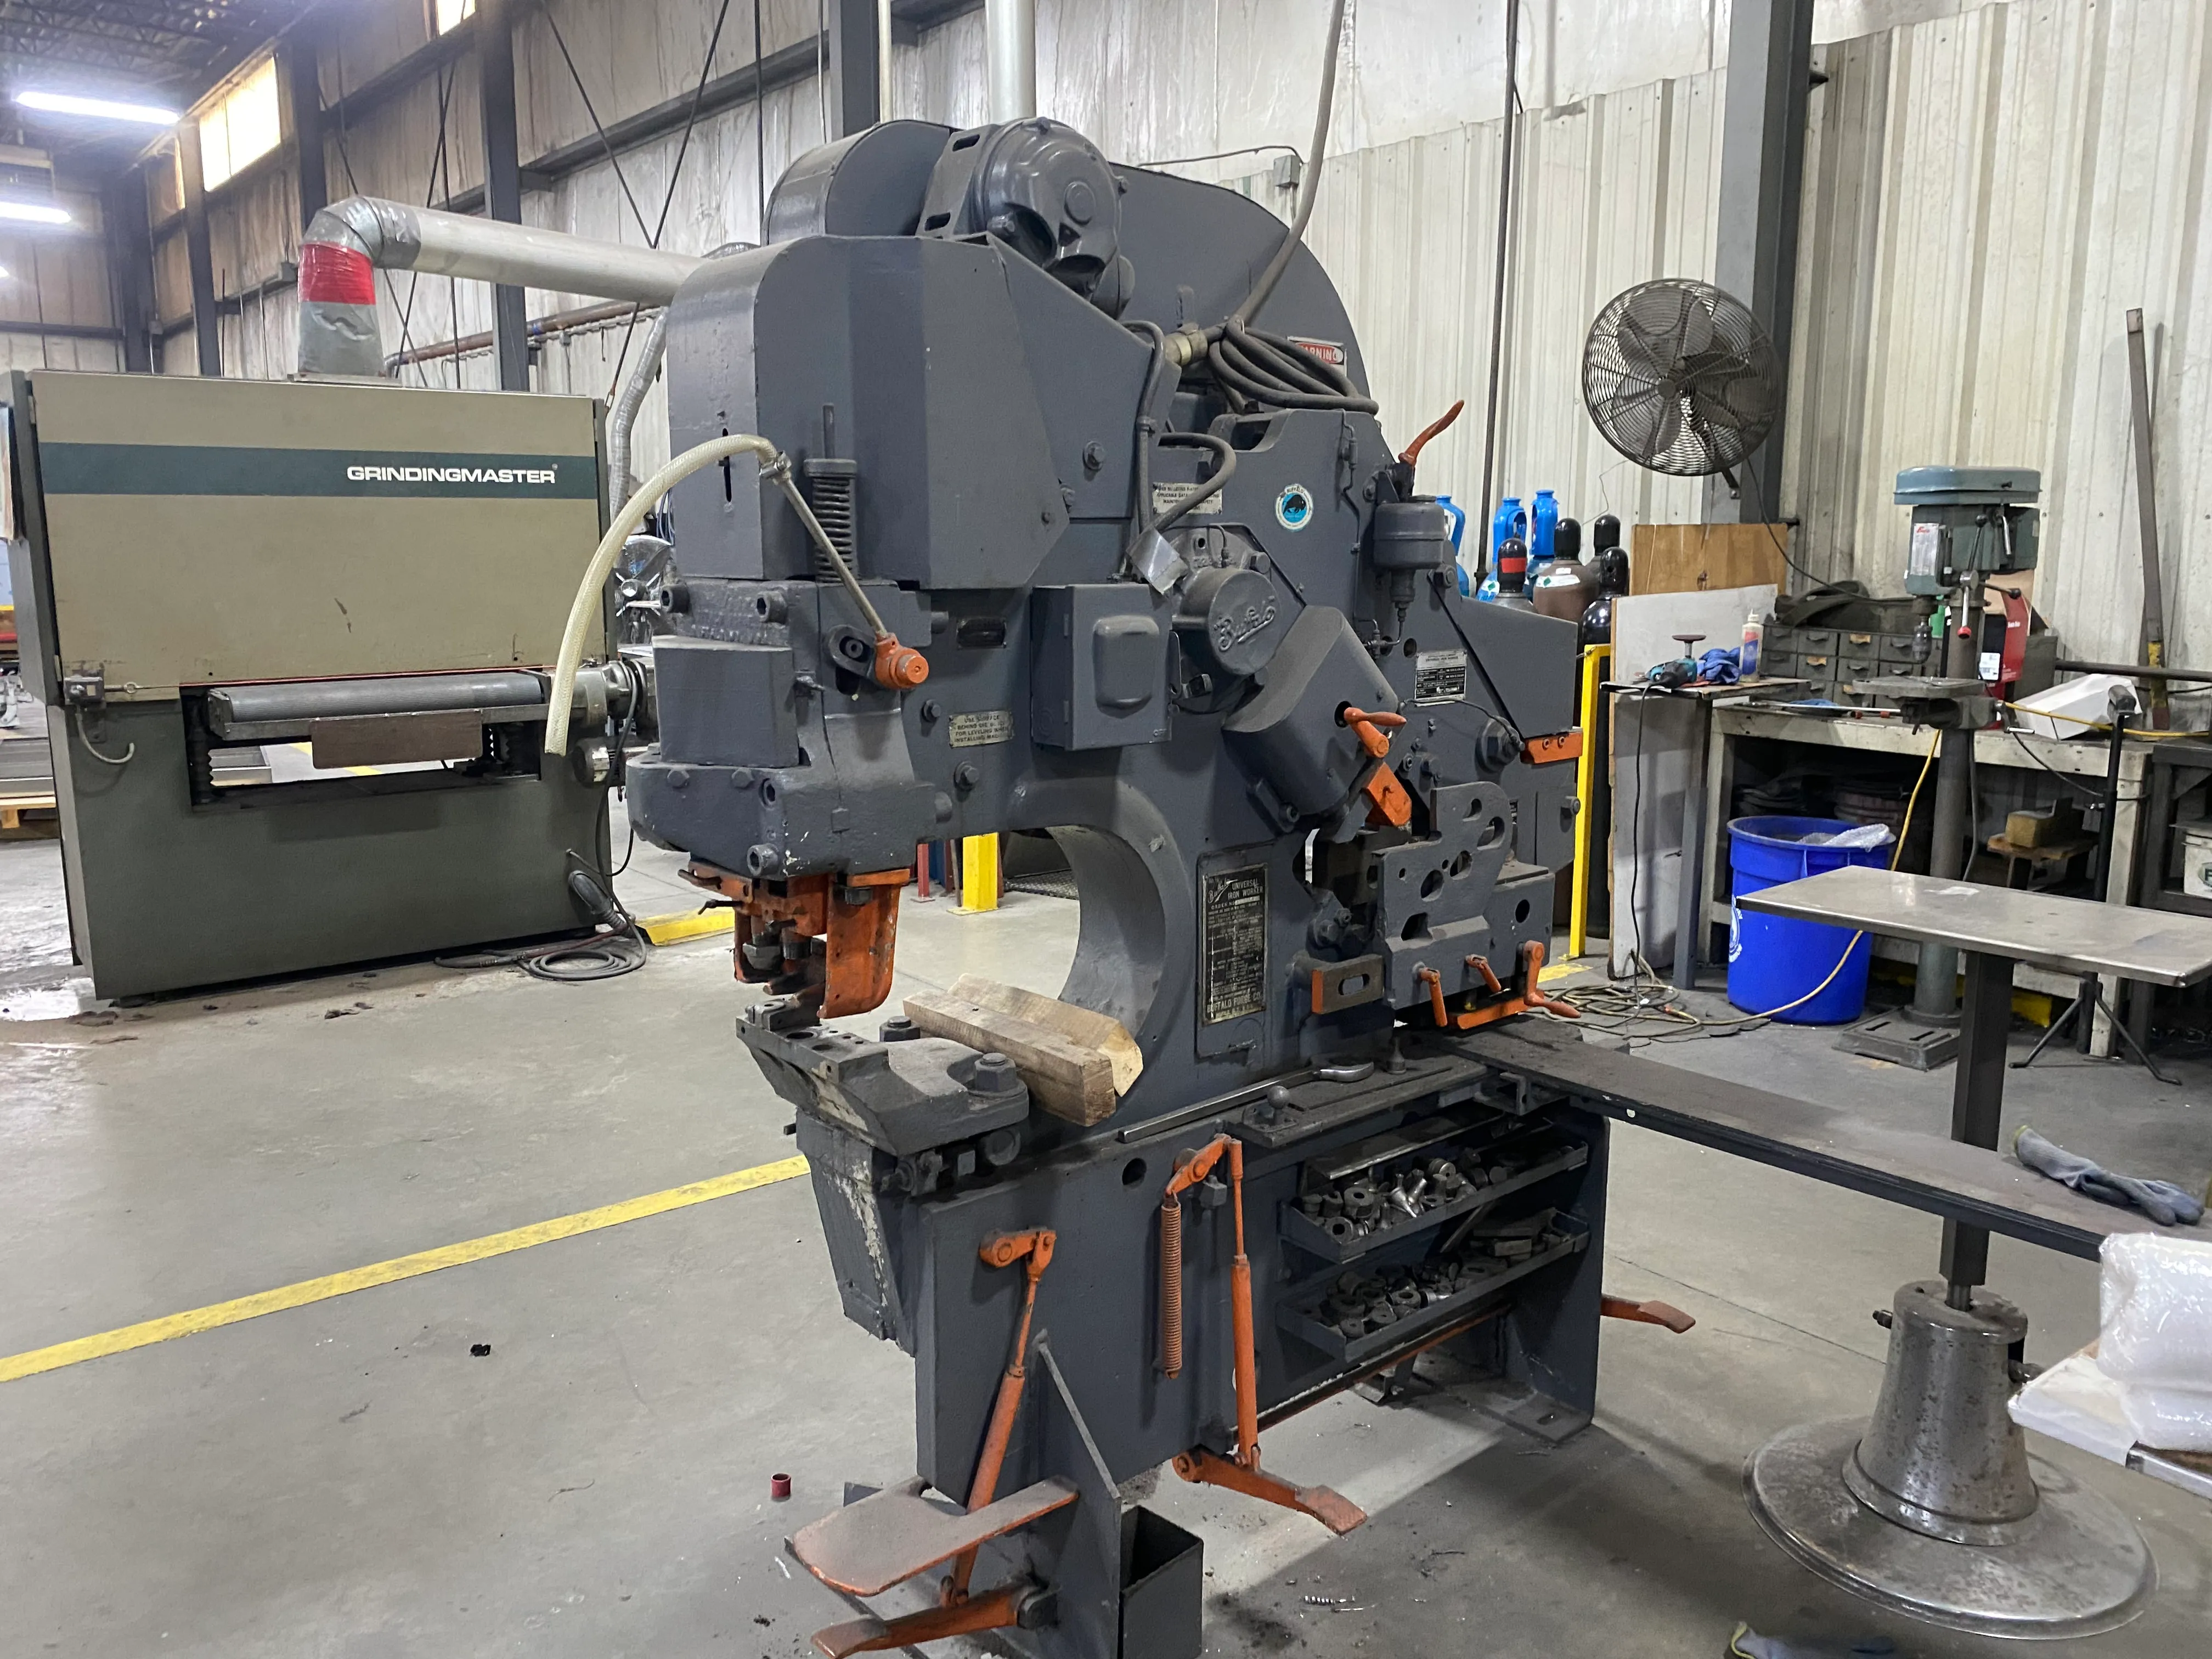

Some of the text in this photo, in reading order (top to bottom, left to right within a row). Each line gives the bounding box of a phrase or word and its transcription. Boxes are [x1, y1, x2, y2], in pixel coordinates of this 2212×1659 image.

[1301, 346, 1336, 360] RNING
[347, 466, 555, 483] GRINDINGMASTER
[1232, 878, 1259, 890] UNIVERSAL
[1228, 885, 1263, 900] IRON WORKER
